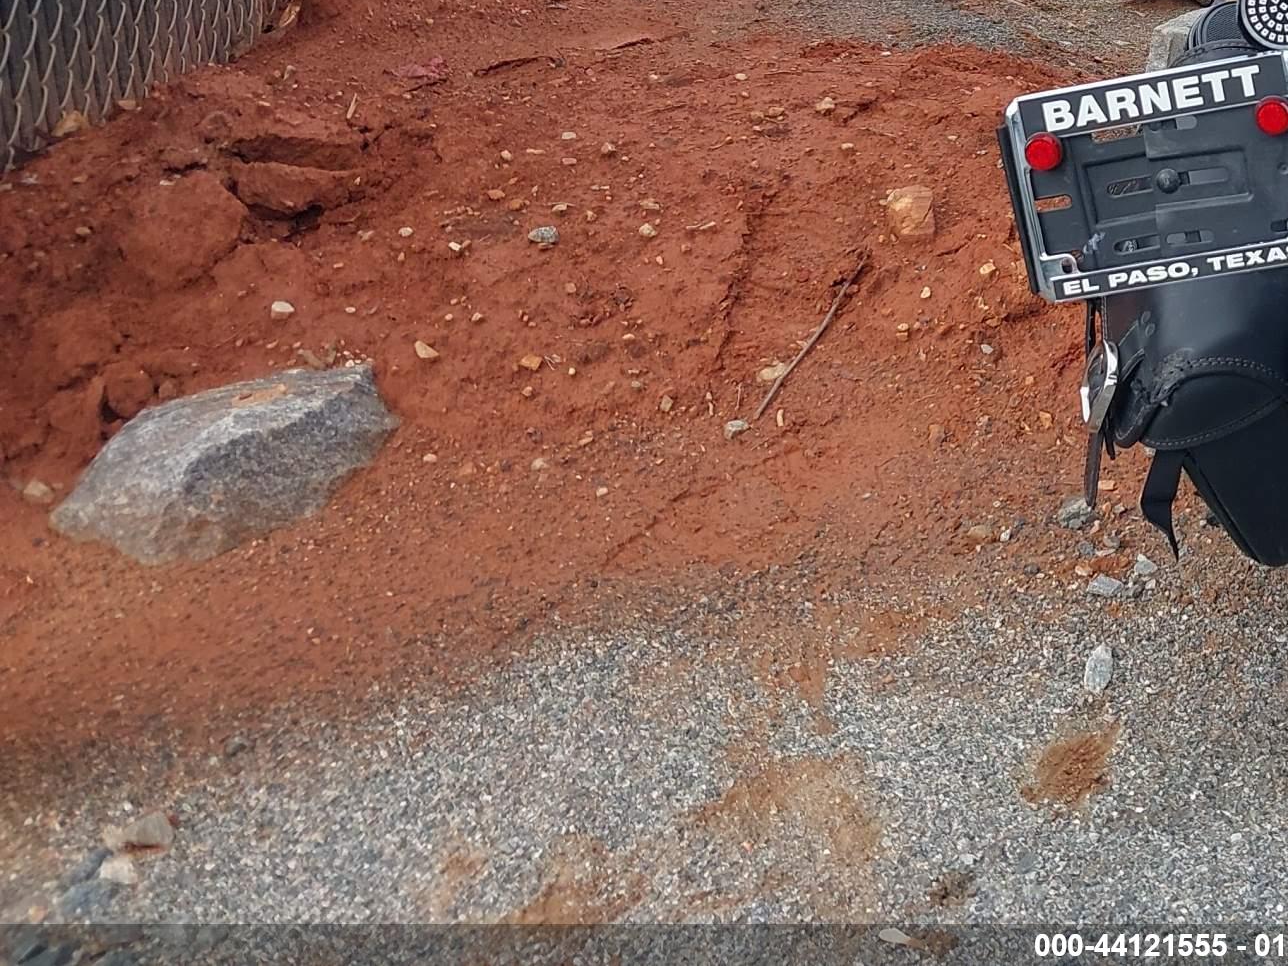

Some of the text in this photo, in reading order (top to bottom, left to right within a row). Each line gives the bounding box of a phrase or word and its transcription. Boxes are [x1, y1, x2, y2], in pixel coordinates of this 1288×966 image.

[1042, 65, 1260, 132] BARNETT
[1063, 277, 1100, 296] EL
[1108, 261, 1199, 288] PASO,
